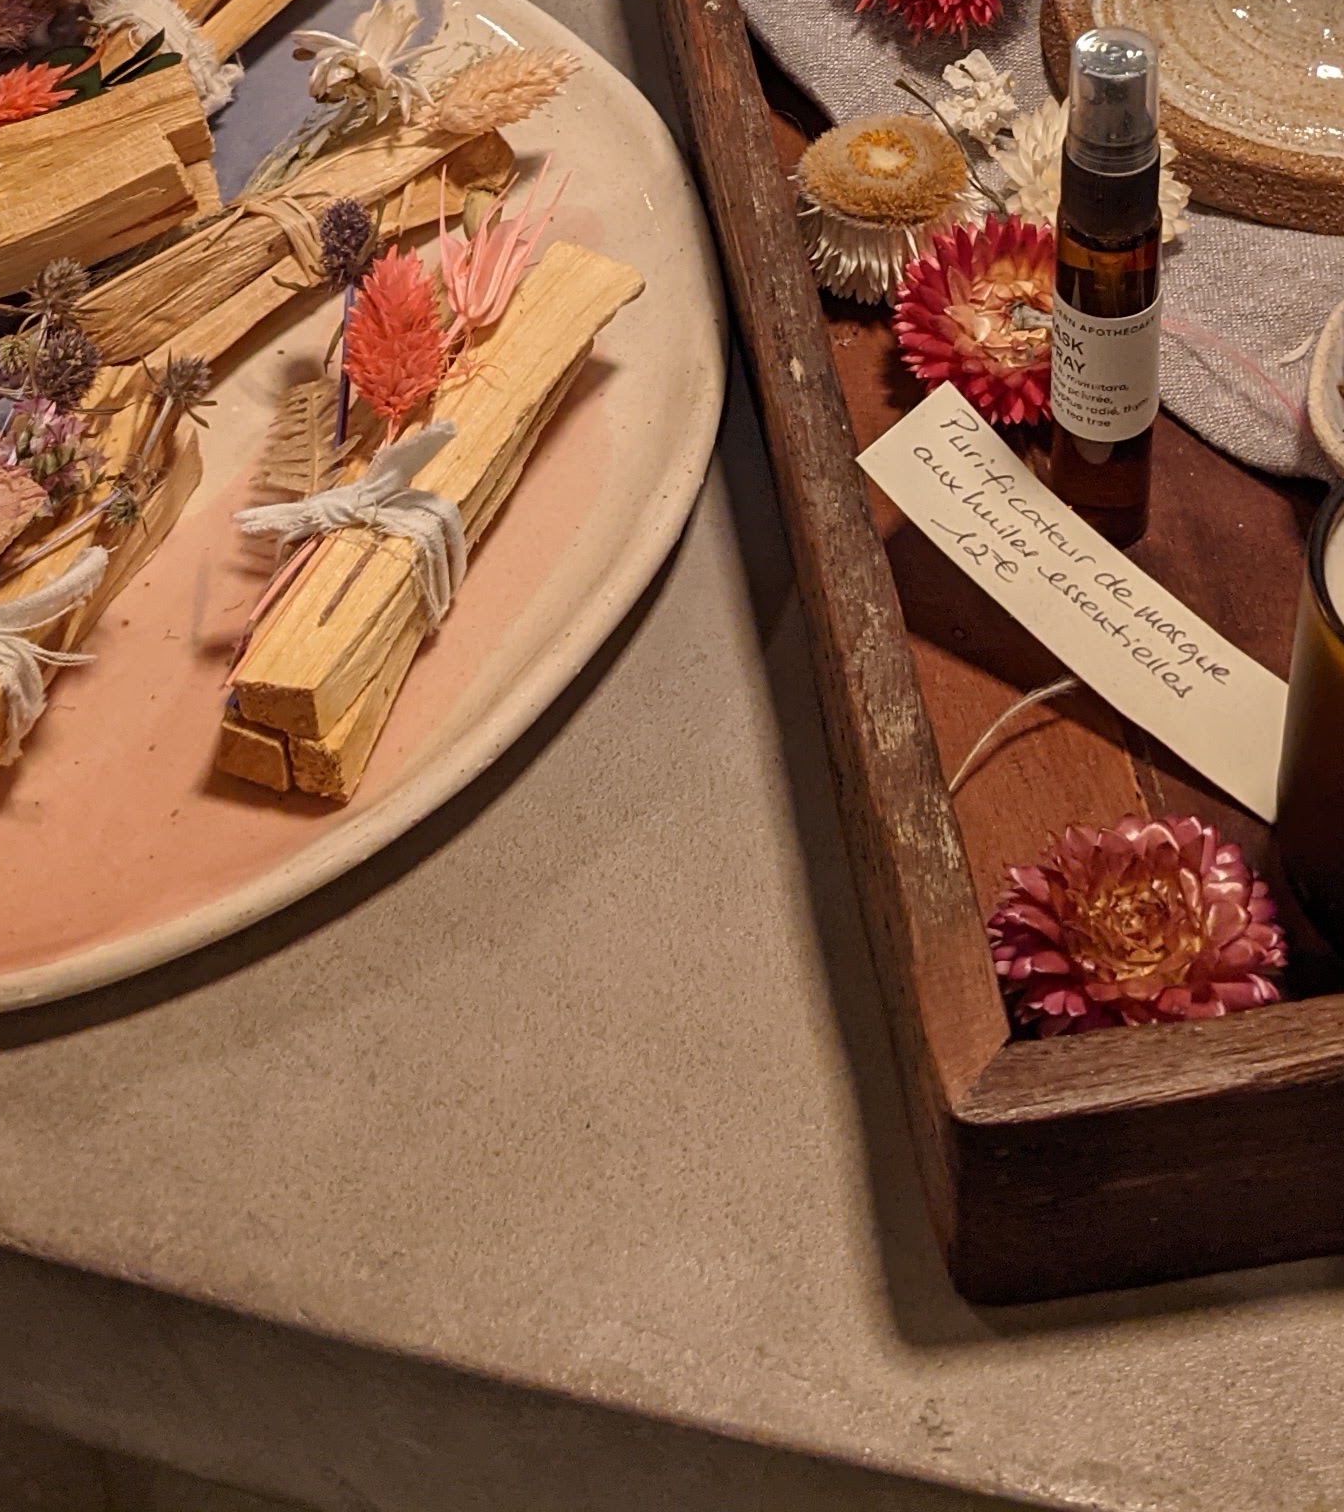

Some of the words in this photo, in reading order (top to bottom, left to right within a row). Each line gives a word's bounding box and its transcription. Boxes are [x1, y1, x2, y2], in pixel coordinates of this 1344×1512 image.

[1054, 323, 1084, 355] ASK
[1054, 345, 1086, 374] RAY
[913, 447, 963, 495] aux
[962, 491, 1039, 558] huiles
[1036, 566, 1193, 698] essentielles
[930, 519, 1019, 583] 12€
[940, 408, 1097, 565] Purificateur
[1094, 572, 1134, 609] de
[1134, 605, 1231, 685] masque
